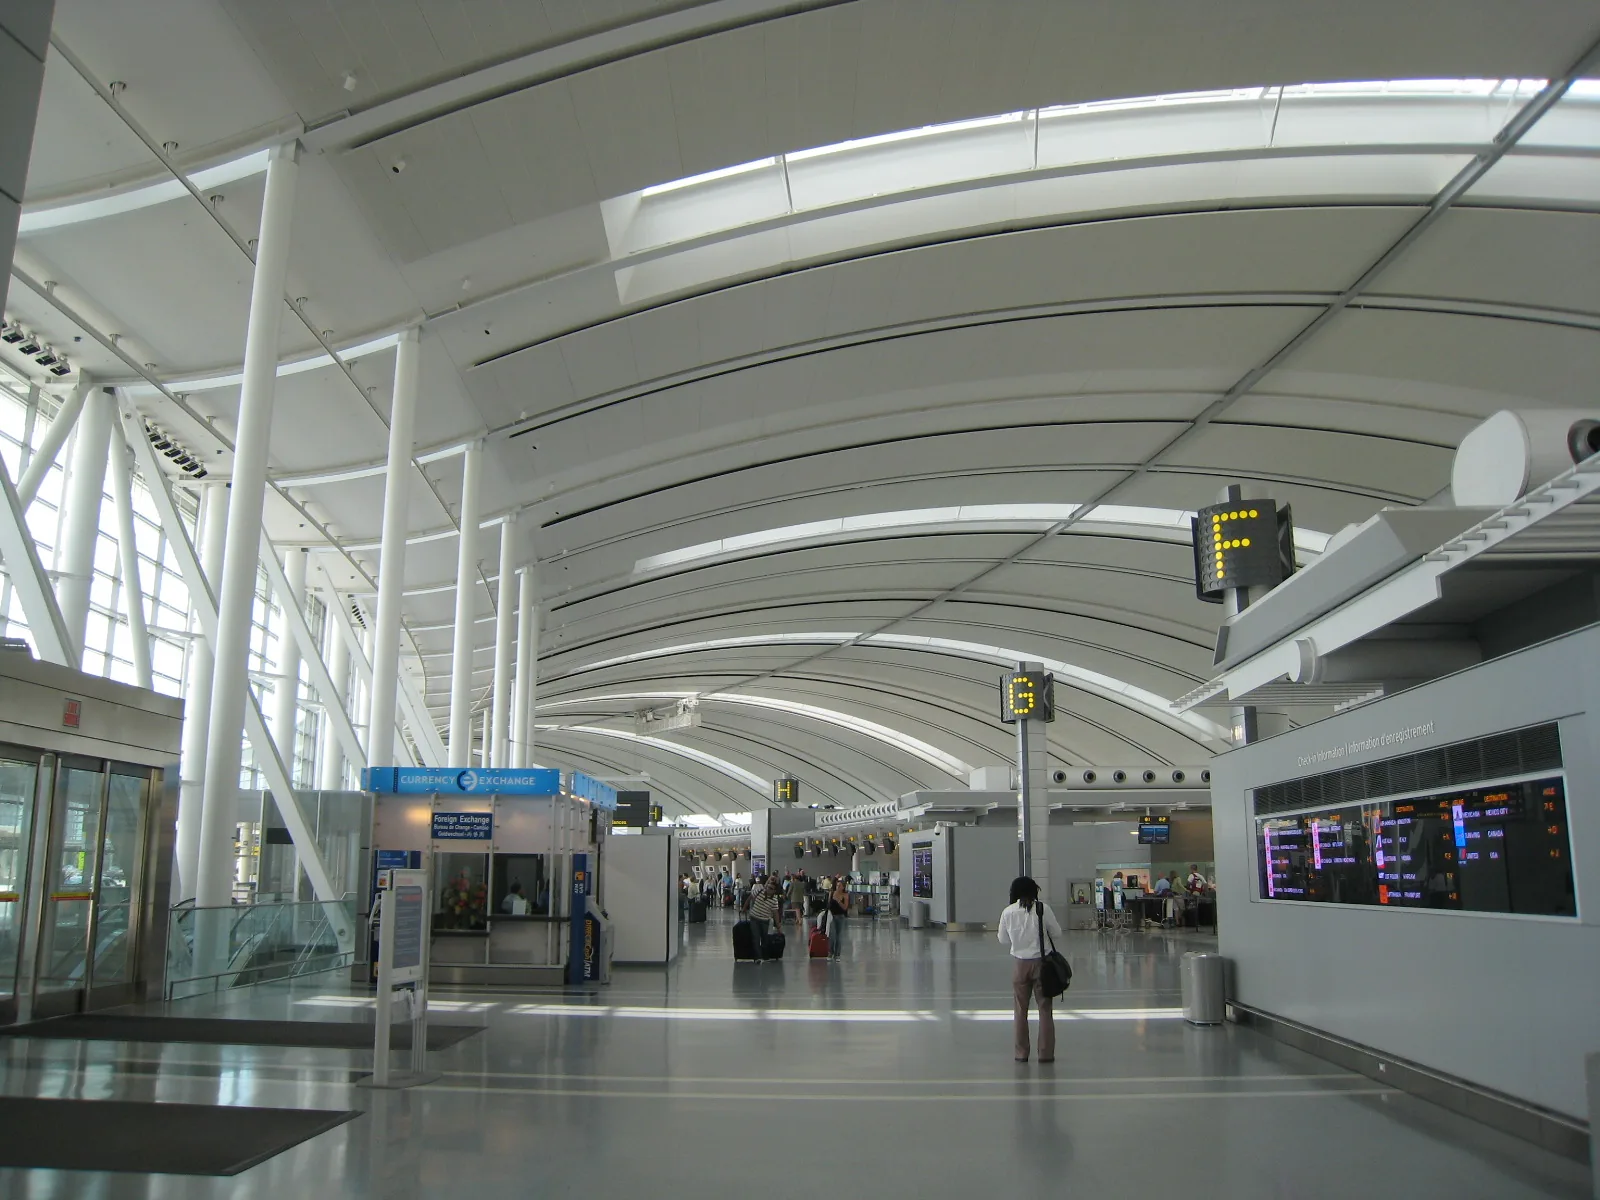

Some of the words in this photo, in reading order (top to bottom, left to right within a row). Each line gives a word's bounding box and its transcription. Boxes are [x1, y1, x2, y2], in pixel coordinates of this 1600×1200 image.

[1212, 509, 1258, 579] F
[1009, 677, 1034, 714] G
[1297, 754, 1316, 767] Check-in
[1317, 745, 1345, 762] Information
[1348, 735, 1380, 755] Information
[1380, 720, 1435, 745] d'enregistrement
[400, 775, 456, 785] CURRENCY
[479, 776, 536, 786] EXCHANGE
[777, 781, 790, 799] H
[434, 815, 457, 824] Foreign
[460, 815, 490, 825] Exchange
